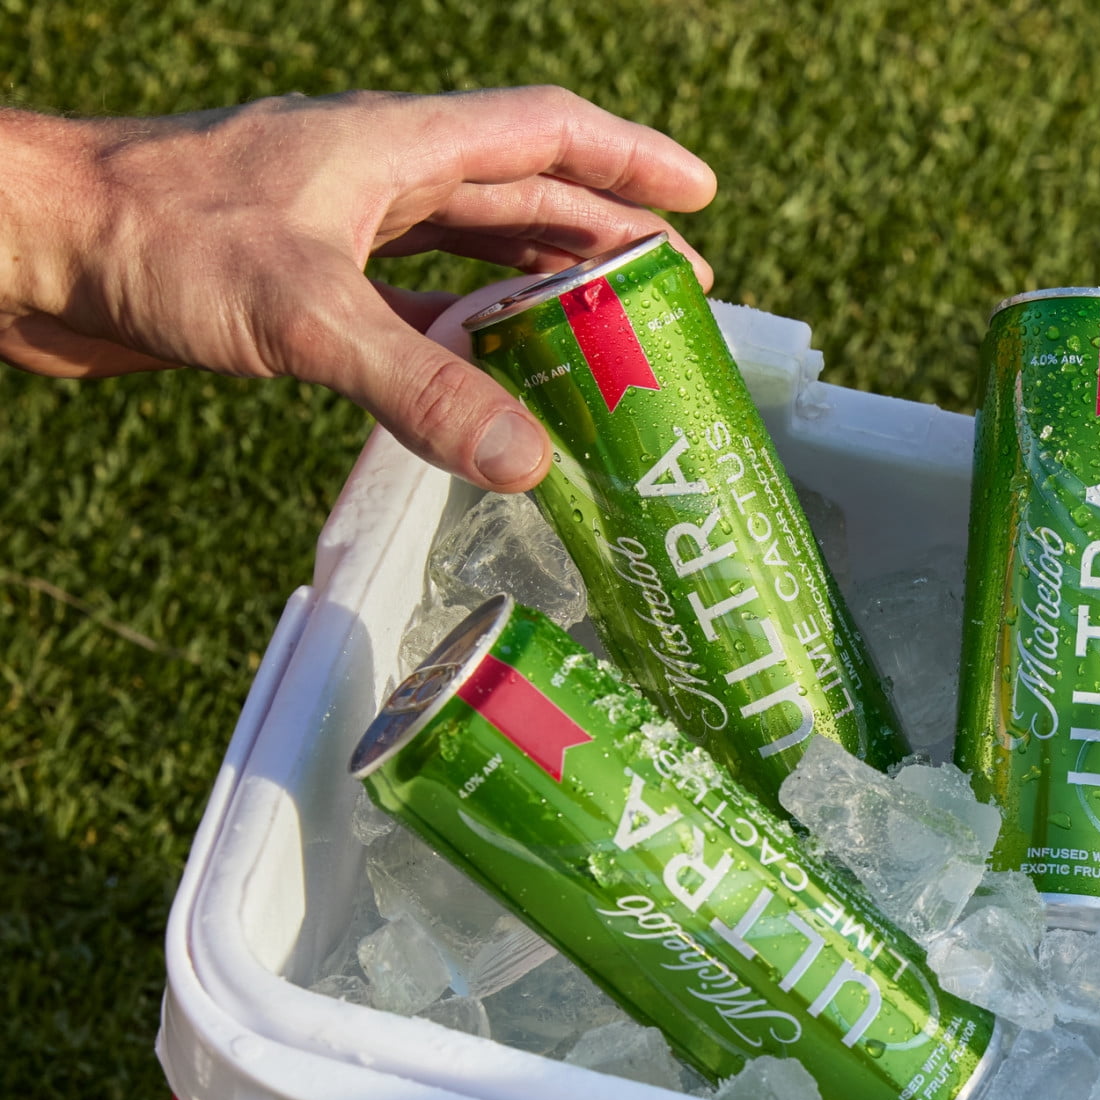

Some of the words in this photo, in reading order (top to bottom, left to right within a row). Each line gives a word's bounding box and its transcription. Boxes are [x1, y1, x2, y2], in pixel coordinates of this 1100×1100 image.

[551, 362, 572, 380] ABV
[1030, 354, 1058, 367] 4.0%
[1061, 355, 1083, 366] ABV
[742, 436, 778, 508] CACTUS
[706, 421, 800, 602] CACTUS
[775, 510, 802, 556] PEAR
[593, 518, 729, 731] Michelob
[634, 435, 815, 760] ULTRA
[799, 561, 834, 631] PRICKLY
[1013, 503, 1065, 740] Michelob
[793, 614, 855, 720] LIME
[841, 649, 863, 689] LIME
[458, 772, 485, 799] 4.0%
[482, 753, 503, 777] ABV
[653, 750, 809, 892] CACTUS
[1027, 848, 1089, 861] INFUSED
[1020, 863, 1070, 875] EXOTIC
[613, 773, 882, 1049] ULTRA
[816, 893, 910, 982] LIME
[597, 895, 802, 1048] Michelob
[922, 1042, 947, 1074] WITH
[943, 1016, 963, 1043] REAL
[923, 1062, 953, 1100] FRUIT
[950, 1020, 977, 1063] FLAVOR
